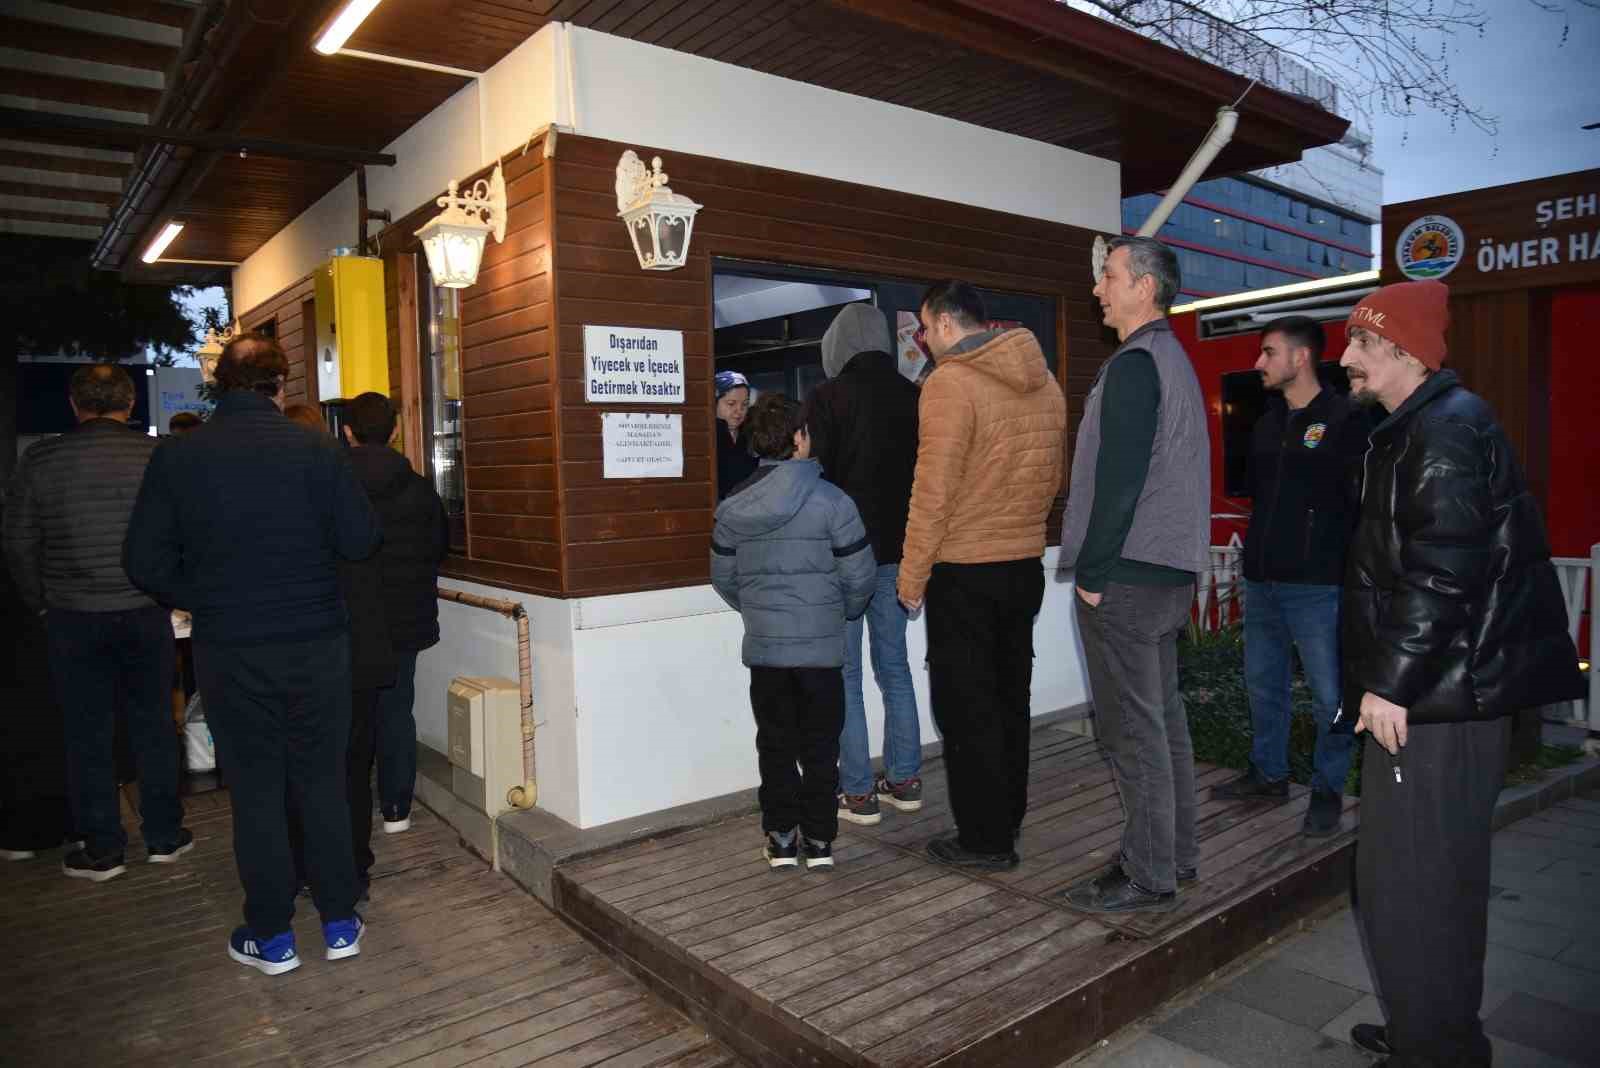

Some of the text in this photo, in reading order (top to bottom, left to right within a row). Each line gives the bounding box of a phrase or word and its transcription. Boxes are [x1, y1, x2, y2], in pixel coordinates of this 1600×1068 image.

[1477, 237, 1560, 273] ÖMER
[609, 334, 658, 353] Dışarıdan
[591, 354, 680, 377] Yiyecek ve İçecek
[591, 379, 681, 396] Getirmek Yasaktır
